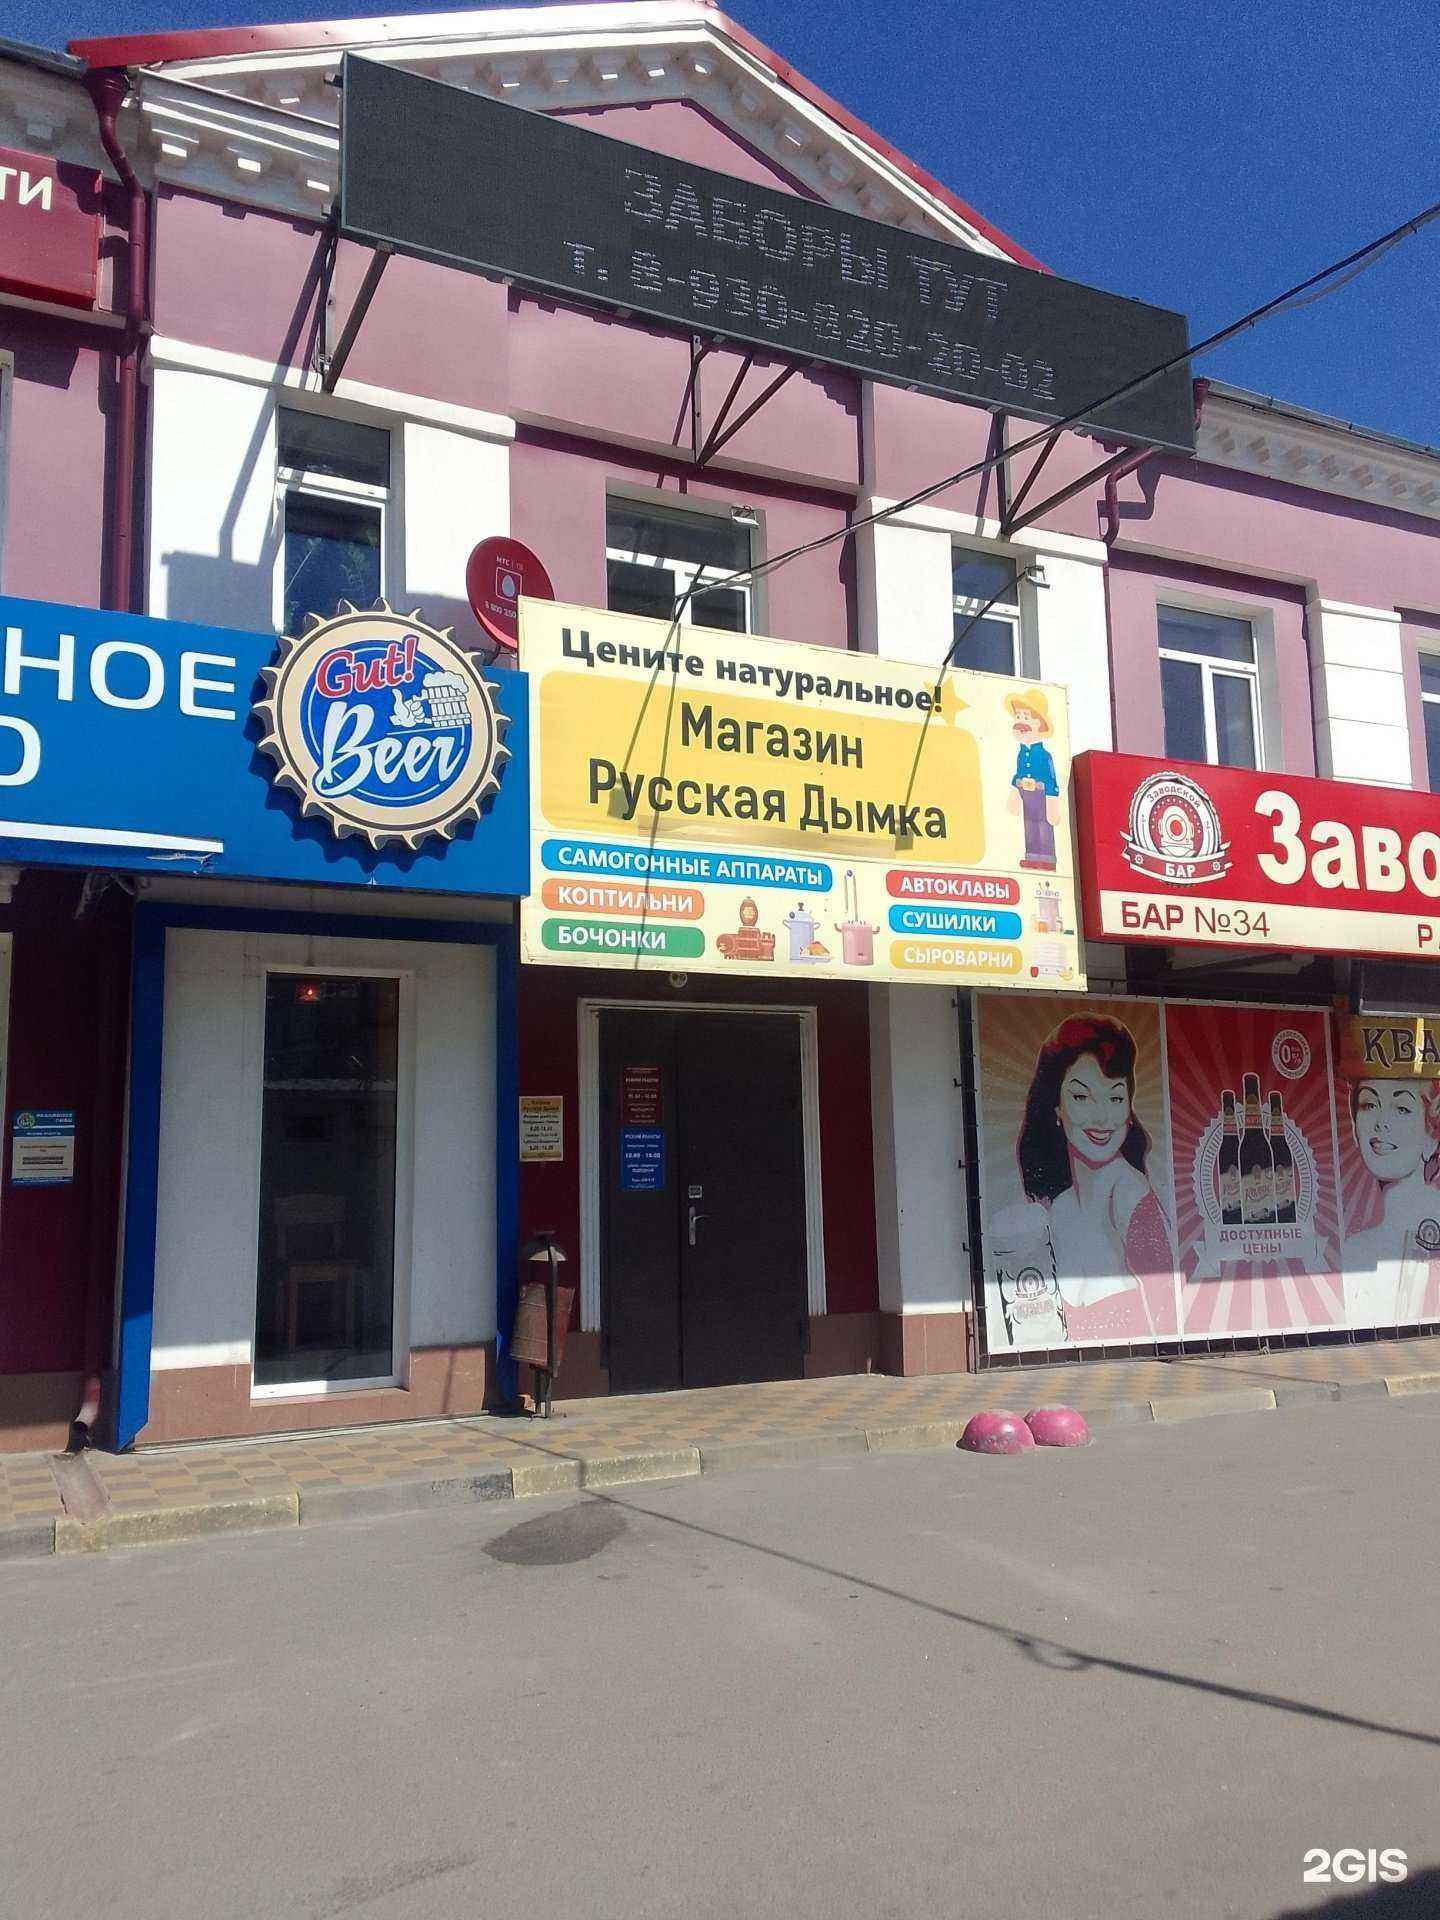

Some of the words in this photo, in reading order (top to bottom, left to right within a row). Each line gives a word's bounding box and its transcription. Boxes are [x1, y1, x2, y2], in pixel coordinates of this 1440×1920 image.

[624, 167, 889, 290] ЗАБОРЫ
[906, 255, 1008, 320] ТУТ
[629, 250, 1056, 401] 8-930-820-20-02
[3, 627, 236, 721] НОЕ
[315, 634, 420, 699] Gut!
[561, 627, 704, 678] Цените
[716, 658, 943, 713] натуральное!
[314, 700, 466, 799] Beer
[681, 702, 865, 769] Магазин
[589, 758, 787, 822] Русская
[800, 783, 948, 840] Дымка
[1146, 785, 1202, 808] Заводской
[1254, 789, 1440, 898] Заво
[557, 846, 711, 879] САМОГОННЫЕ
[716, 859, 824, 887] АППАРАТЫ
[1165, 863, 1196, 878] БАР
[557, 885, 694, 914] КОПТИЛЬНИ
[900, 876, 1011, 900] АВТОКЛАВЫ
[557, 925, 667, 950] БОЧОНКИ
[902, 911, 997, 933] СУШИЛКИ
[1121, 901, 1184, 931] БАР
[1194, 906, 1271, 938] №34
[1418, 924, 1440, 949] Р
[903, 946, 1014, 969] СЫРОВАРНИ
[1220, 1229, 1302, 1242] ДОСТУПНЫЕ
[1242, 1243, 1281, 1255] ЦЕНЫ
